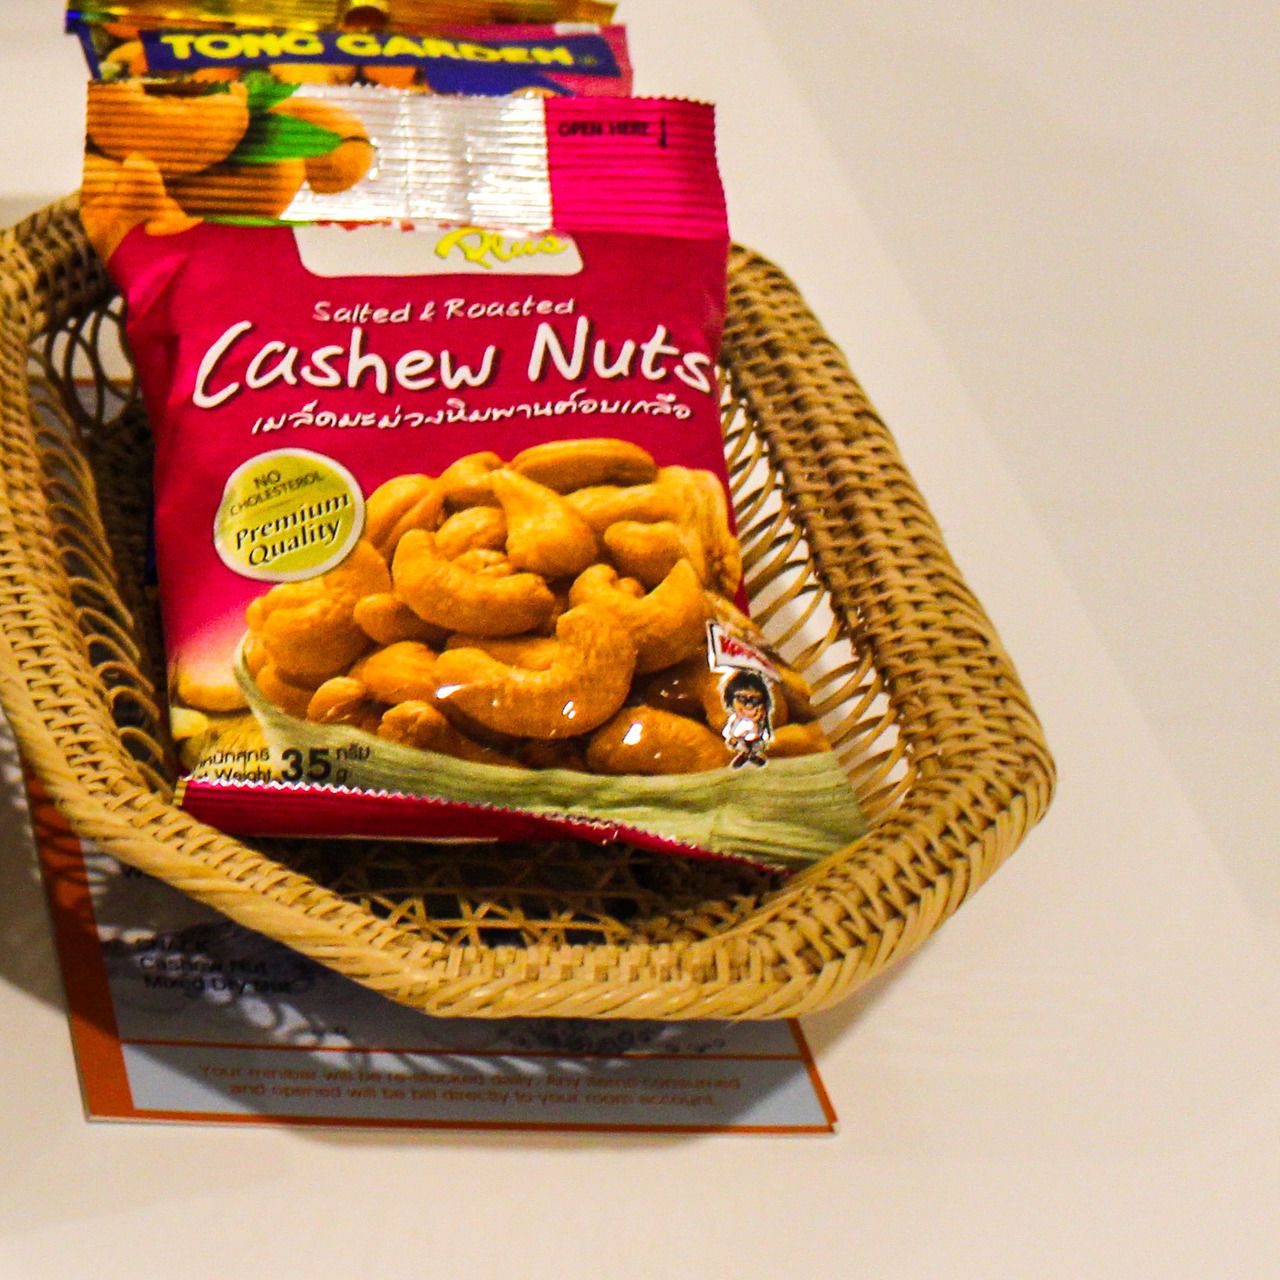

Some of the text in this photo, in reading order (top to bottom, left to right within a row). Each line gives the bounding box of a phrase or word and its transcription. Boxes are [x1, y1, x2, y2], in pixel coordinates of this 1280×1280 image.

[159, 30, 576, 66] TONG GARDEN
[557, 120, 651, 137] OPEN HERE
[312, 295, 577, 325] Salted & Roasted
[191, 316, 714, 409] Cashew Nuts
[229, 471, 324, 517] CHOLESTEROL
[253, 469, 281, 489] NO
[236, 493, 350, 551] Premium
[248, 518, 341, 566] Quality
[214, 769, 272, 783] Weight
[281, 747, 332, 782] 35
